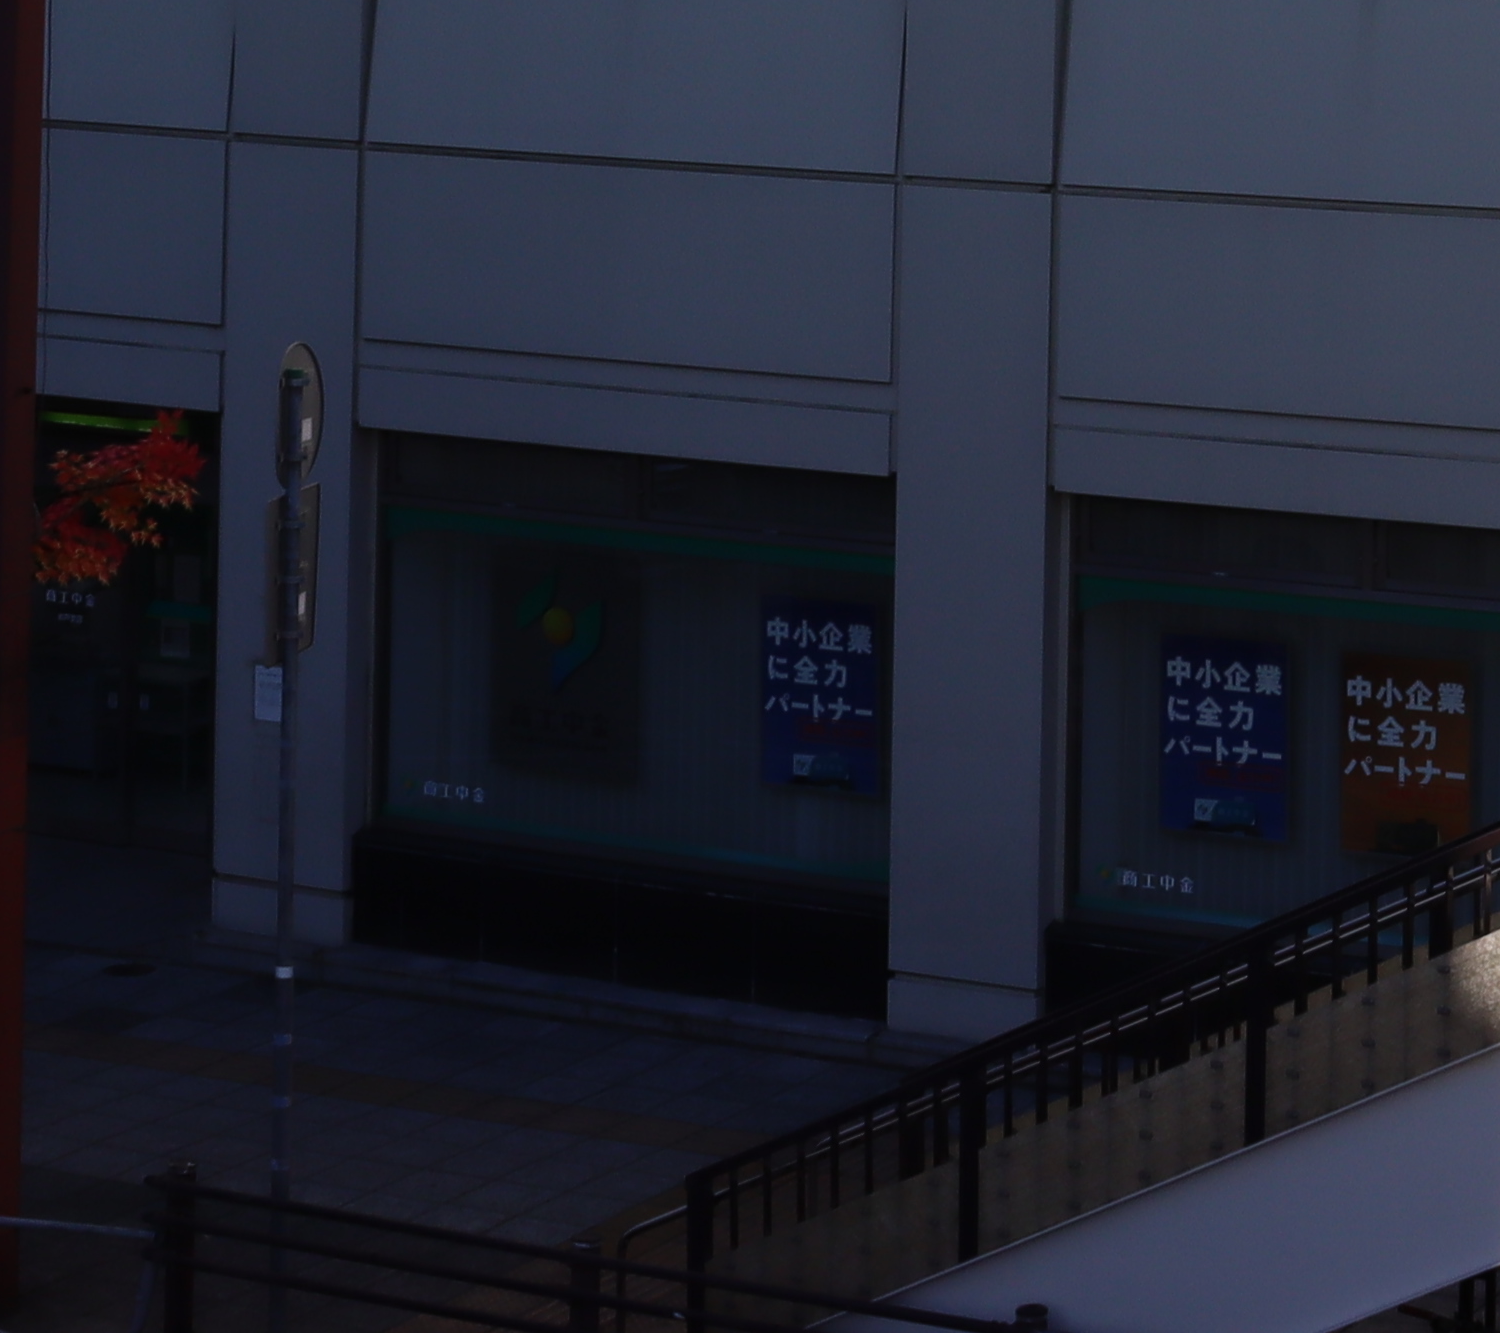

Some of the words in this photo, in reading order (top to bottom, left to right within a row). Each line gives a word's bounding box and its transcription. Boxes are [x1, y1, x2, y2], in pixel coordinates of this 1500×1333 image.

[766, 616, 873, 655] 中小企業
[767, 654, 848, 688] に全力
[1166, 655, 1283, 696] 中小企業
[764, 692, 874, 723] パートナー
[1346, 674, 1466, 714] 中小企業
[1166, 695, 1255, 731] に全力
[1347, 715, 1438, 750] に全力
[1163, 735, 1283, 766] パートナー
[1343, 754, 1467, 787] パートナー
[1122, 870, 1195, 894] 商工中金
